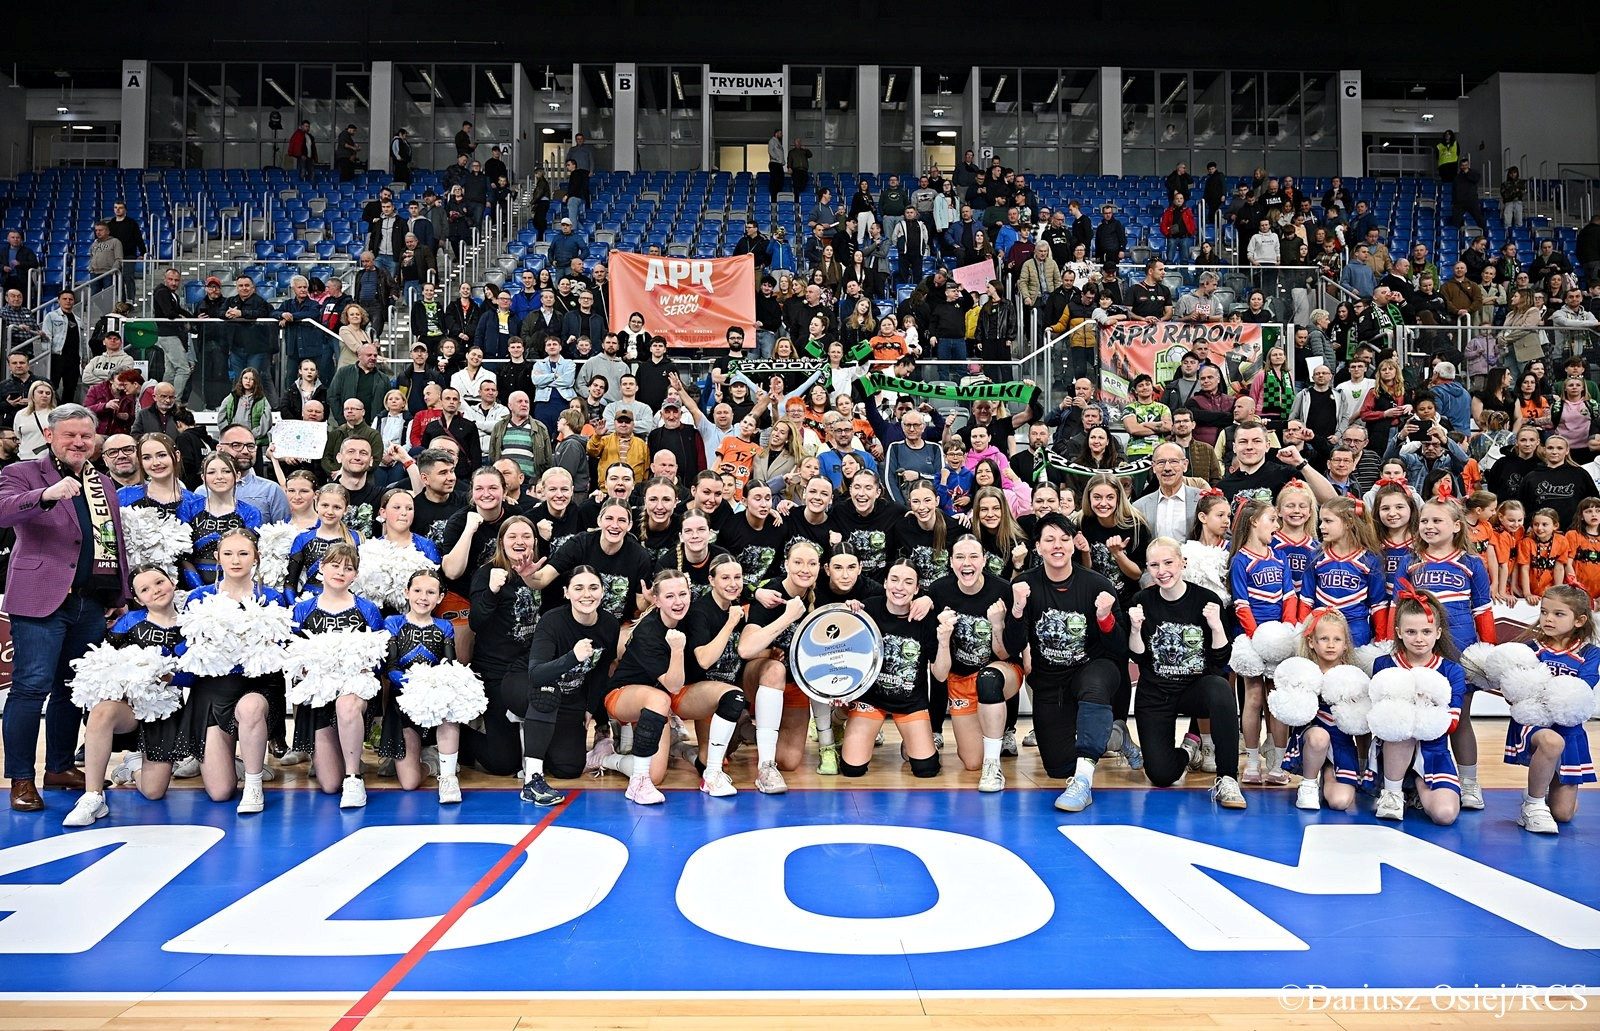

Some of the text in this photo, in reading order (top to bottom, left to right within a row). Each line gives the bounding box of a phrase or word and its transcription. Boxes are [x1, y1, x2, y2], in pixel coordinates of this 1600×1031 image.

[127, 75, 140, 87] A
[619, 78, 631, 90] B
[709, 76, 783, 88] TRYBUNA-1
[1345, 85, 1357, 98] C
[644, 257, 715, 294] APR
[659, 293, 699, 305] W MYM
[663, 302, 699, 317] SERCU
[1107, 323, 1244, 348] APR RADOM
[740, 362, 822, 371] RADOM
[869, 372, 1025, 399] MŁODE WILKI
[1104, 376, 1122, 390] APR
[735, 452, 748, 463] 17
[195, 516, 238, 531] VIBES
[97, 561, 110, 569] APR
[1319, 573, 1359, 589] VIBES
[1414, 571, 1465, 589] VIBES
[0, 823, 1600, 956] ADOM
